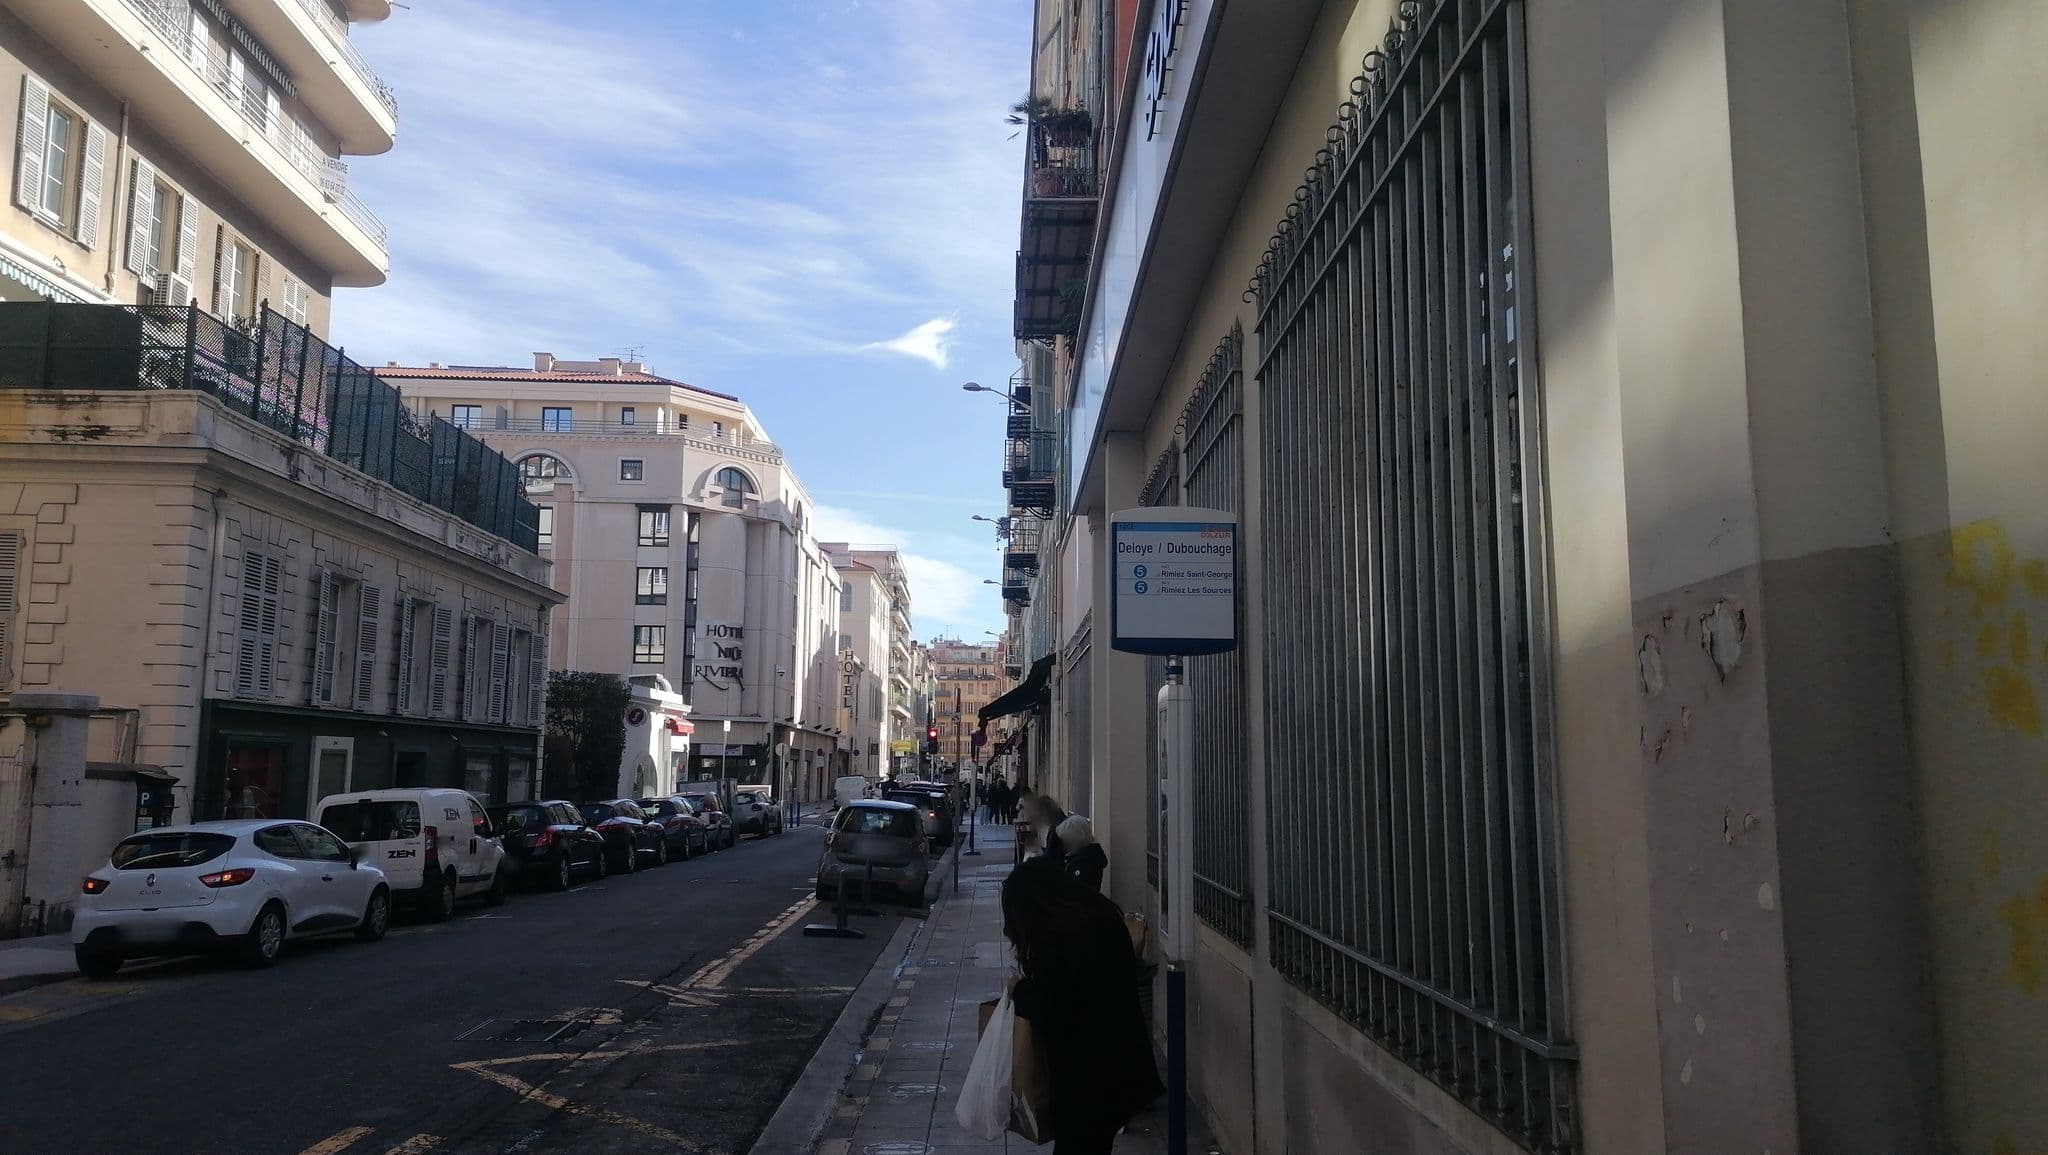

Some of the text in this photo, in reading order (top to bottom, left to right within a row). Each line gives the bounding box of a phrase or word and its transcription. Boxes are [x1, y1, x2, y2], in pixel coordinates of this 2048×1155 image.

[1118, 542, 1153, 556] Deloye
[1167, 542, 1232, 557] Dubouchage
[1161, 570, 1185, 578] Rimiez
[1161, 586, 1185, 594] Rimiez
[1187, 586, 1200, 594] Les
[1202, 586, 1232, 594] Sources
[706, 624, 744, 639] HOTEL
[713, 641, 742, 661] NICE
[695, 665, 745, 691] RIVIERA
[843, 650, 854, 709] HOTEL
[140, 792, 150, 805] P
[443, 807, 461, 821] ZEN
[387, 849, 416, 859] ZEN
